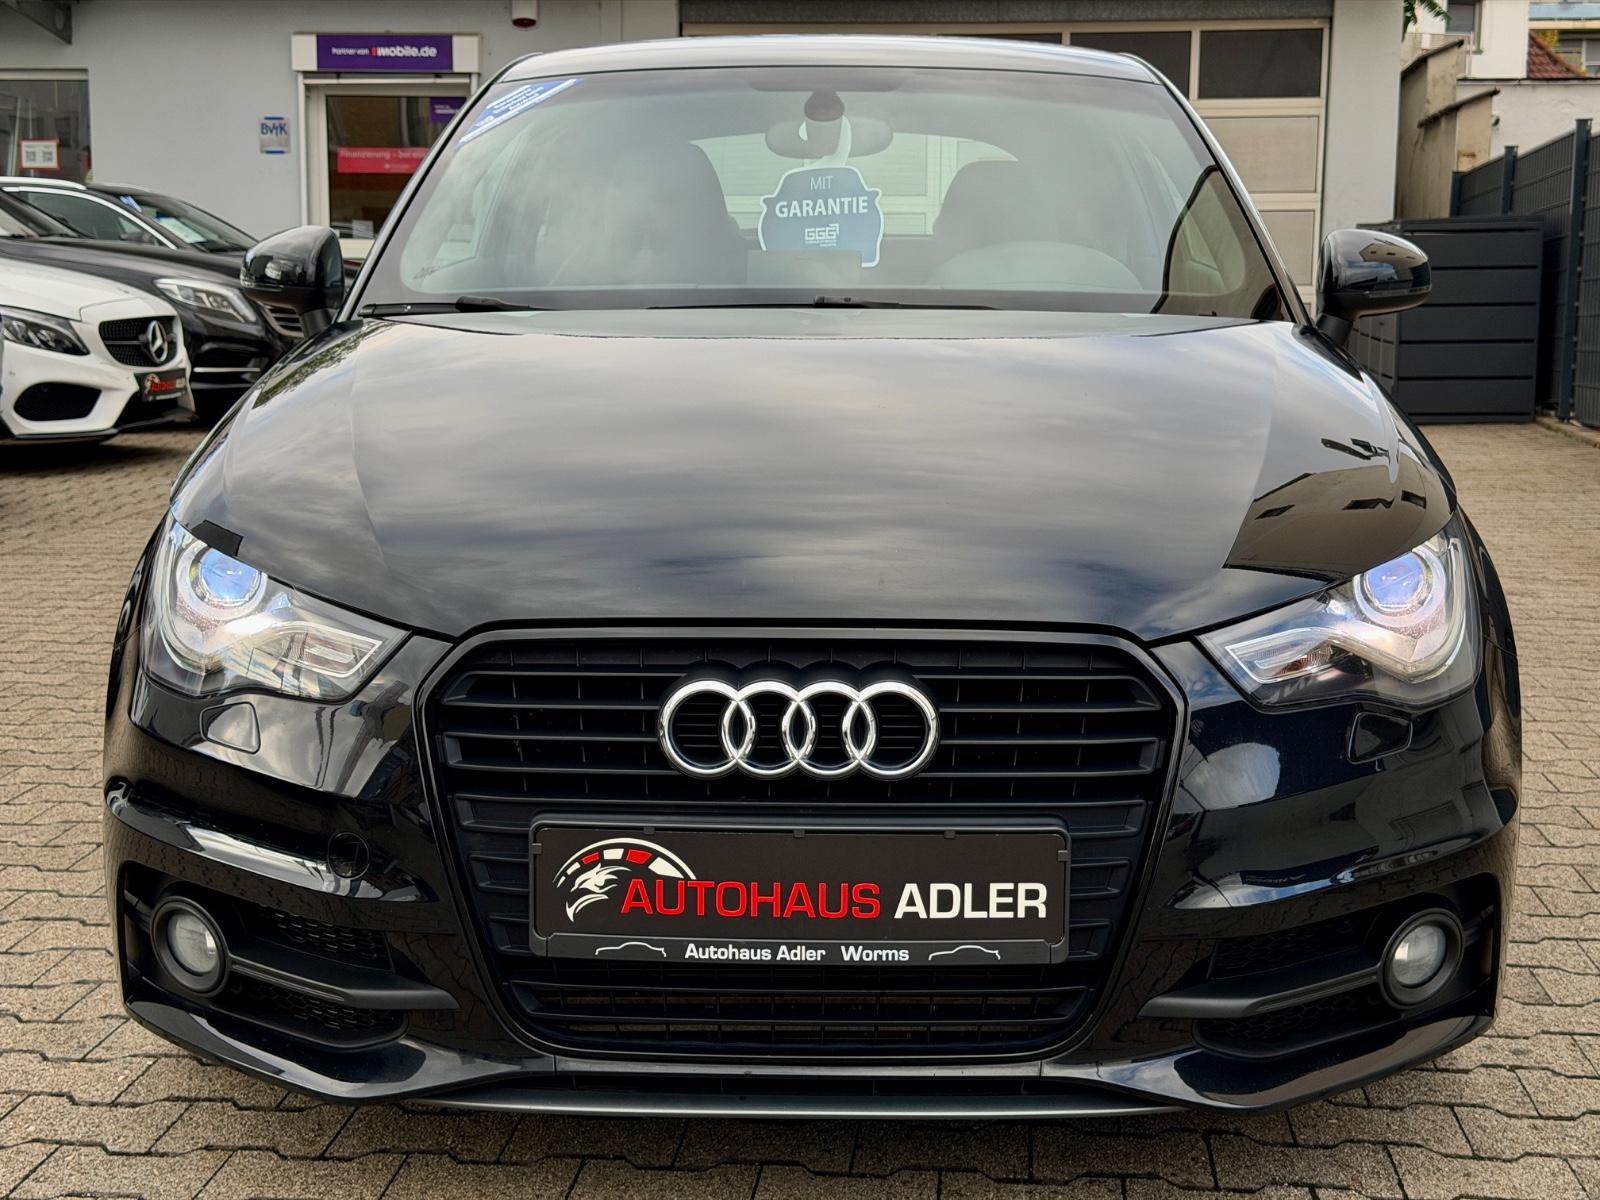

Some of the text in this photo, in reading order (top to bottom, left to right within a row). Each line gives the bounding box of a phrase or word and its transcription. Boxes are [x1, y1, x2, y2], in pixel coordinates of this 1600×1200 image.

[371, 46, 437, 57] mobile.de
[810, 176, 833, 190] MIT
[775, 196, 869, 218] GARANTIE
[620, 878, 1048, 919] AUTOHAUS ADLER
[684, 943, 910, 961] Autohaus Adler Worms
